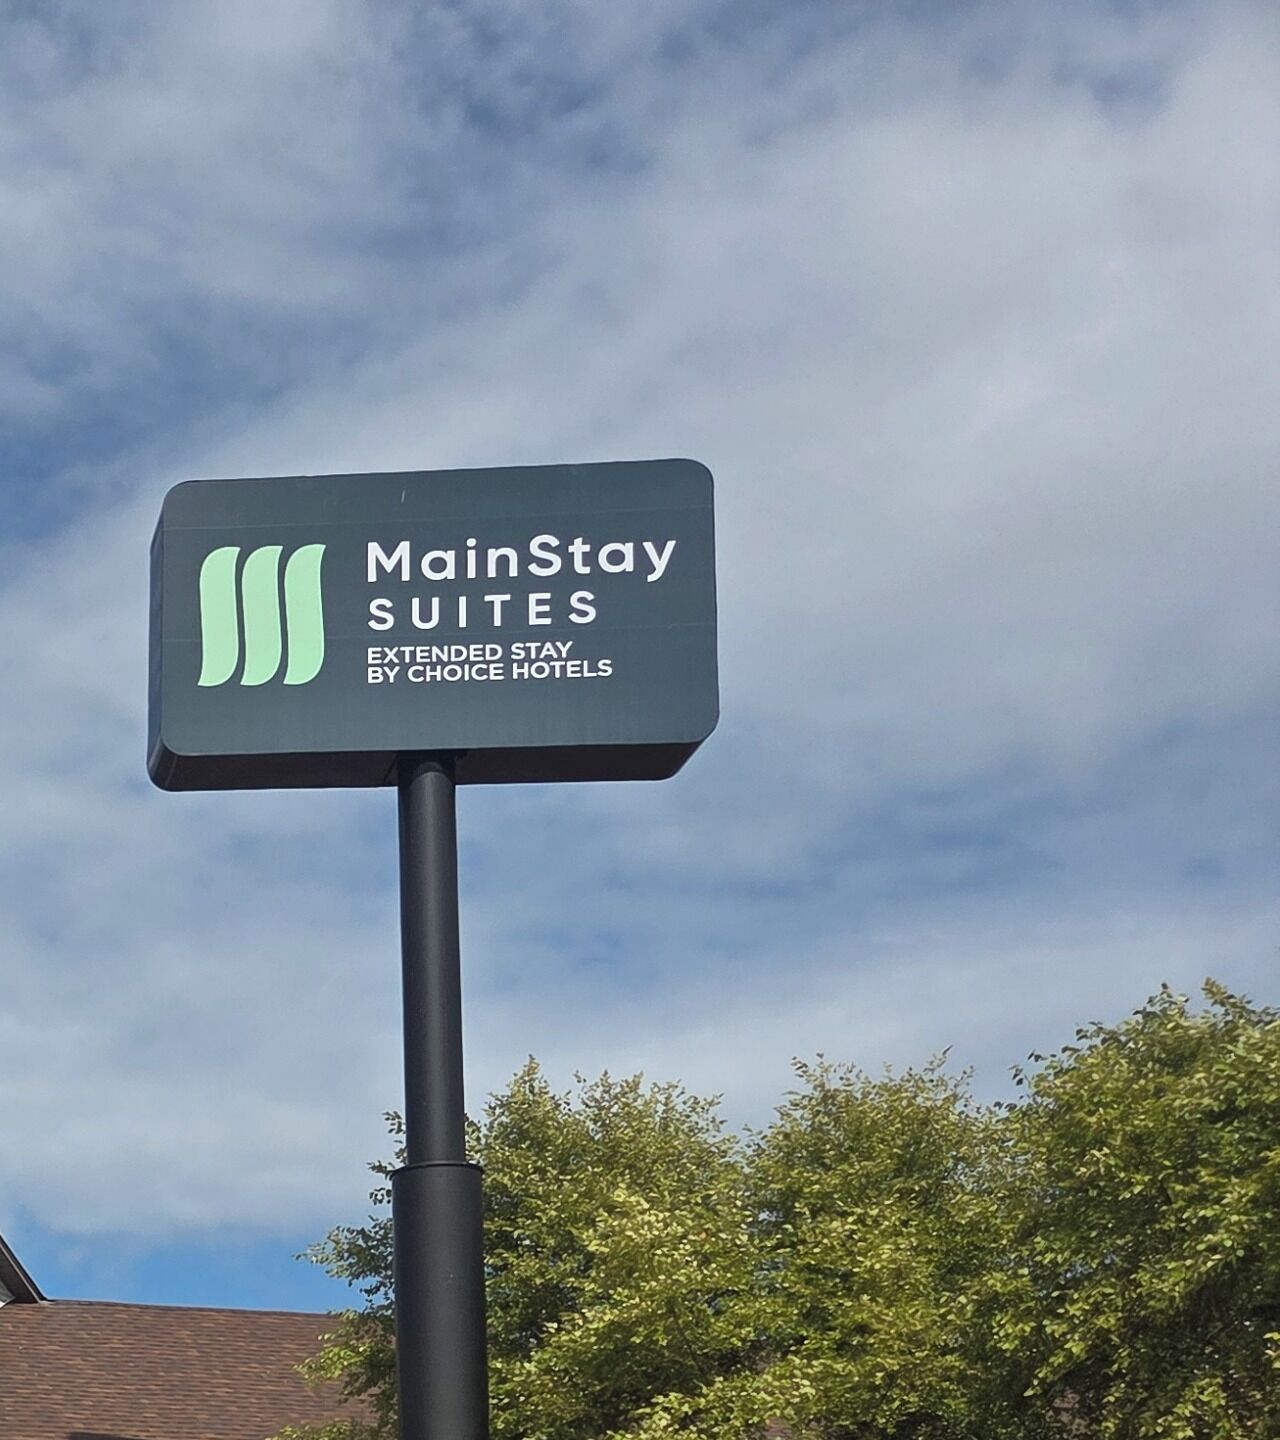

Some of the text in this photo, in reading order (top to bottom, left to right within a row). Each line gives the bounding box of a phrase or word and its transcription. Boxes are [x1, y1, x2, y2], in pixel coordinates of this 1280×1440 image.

[367, 534, 677, 583] MainStay
[367, 590, 597, 631] SUITES
[367, 641, 573, 664] EXTENDED STAY
[367, 659, 613, 684] BY CHOICE HOTELS
